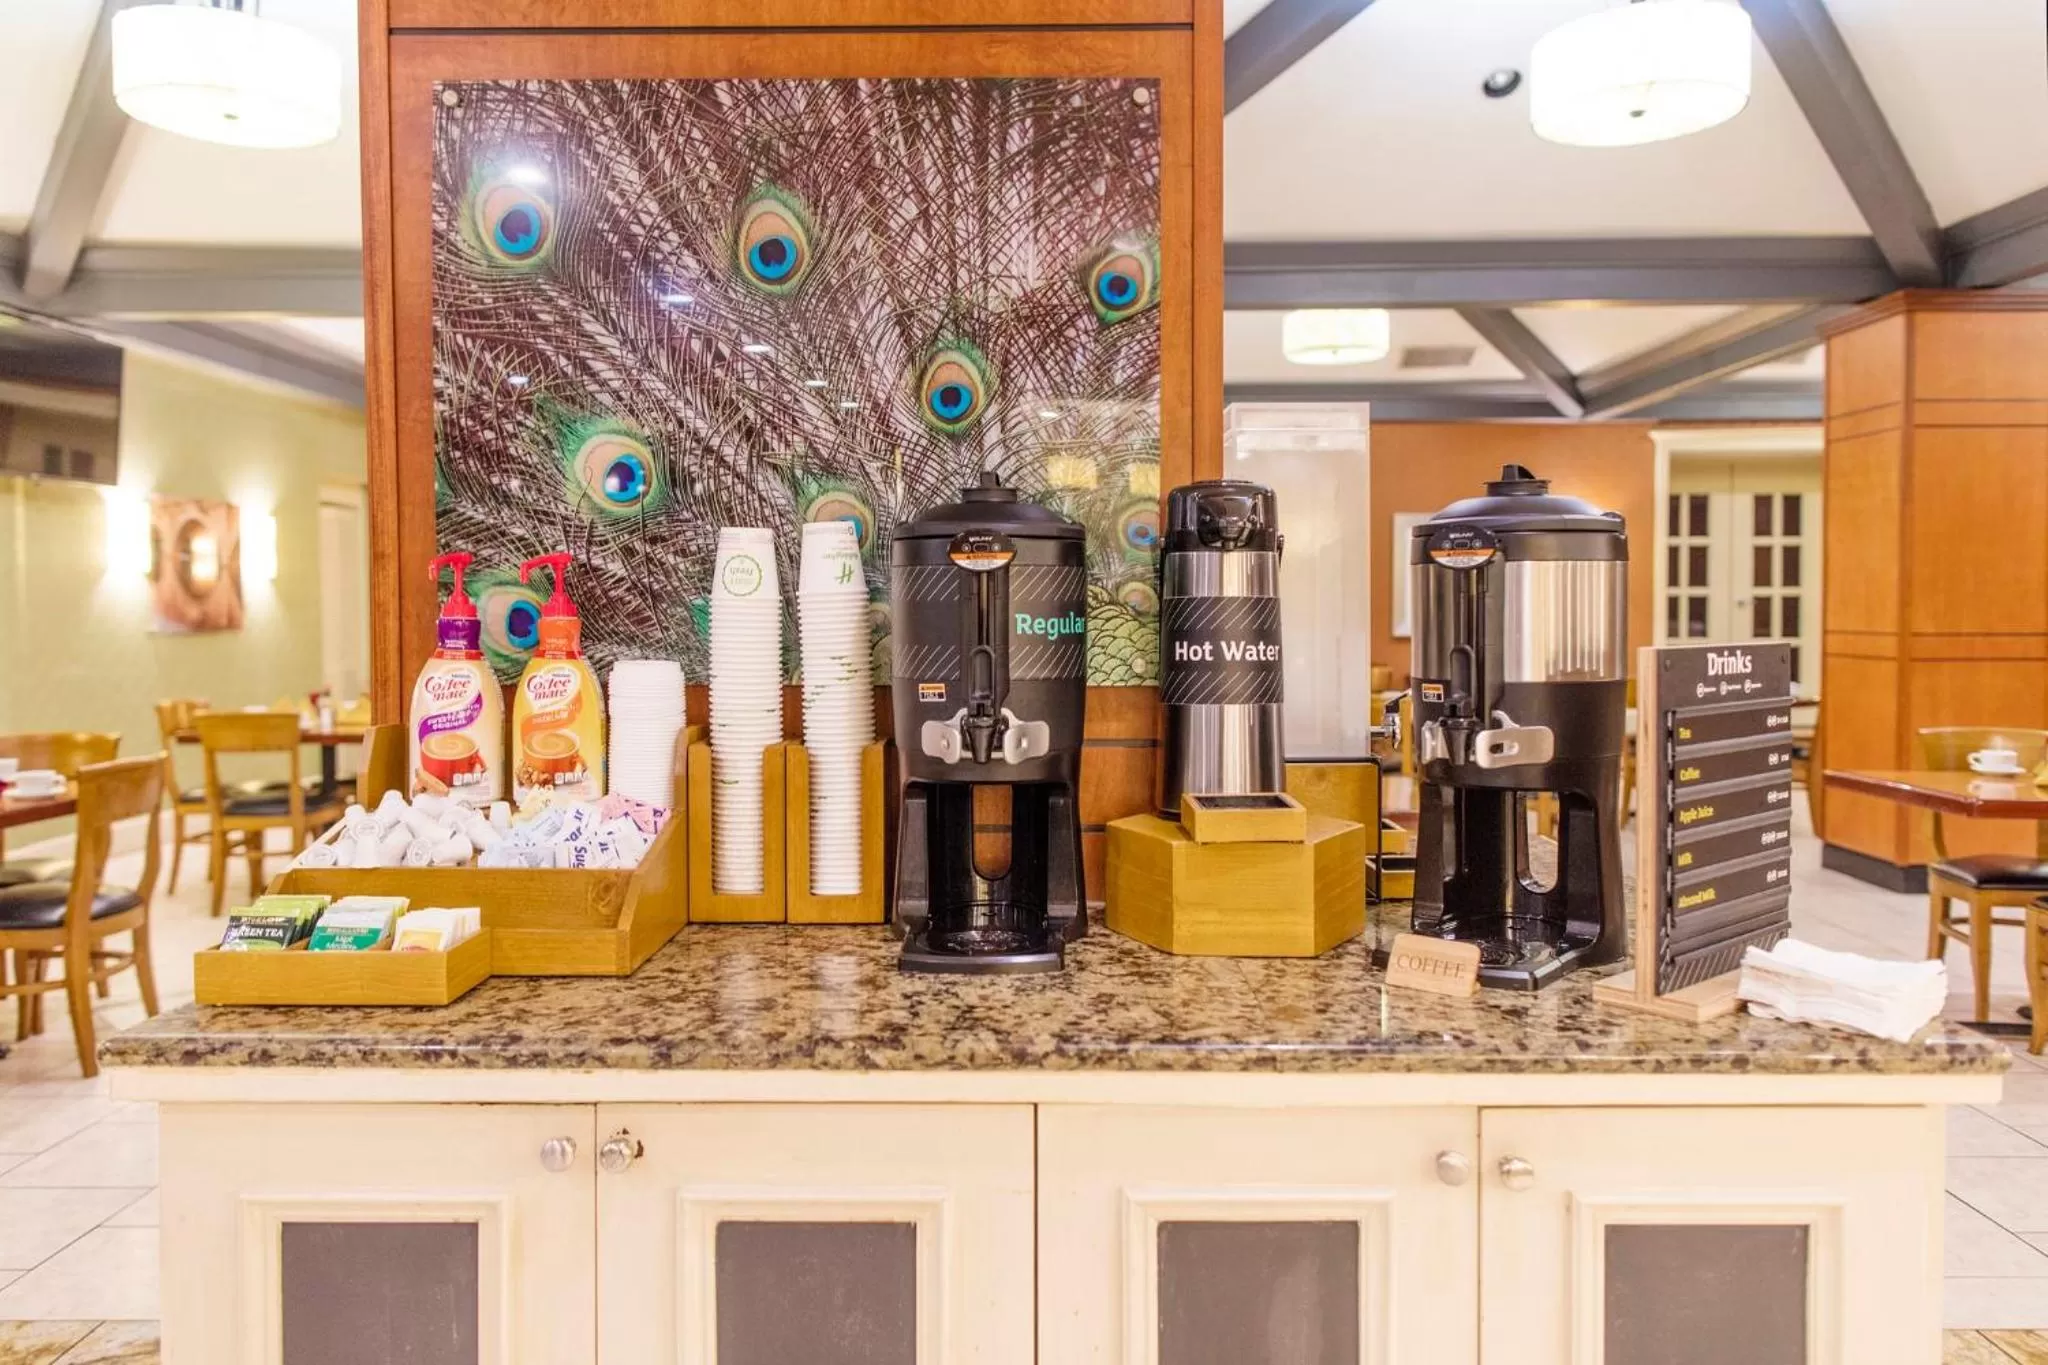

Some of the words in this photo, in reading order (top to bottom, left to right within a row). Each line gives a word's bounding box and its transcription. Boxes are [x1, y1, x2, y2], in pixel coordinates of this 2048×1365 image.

[1175, 641, 1214, 661] Hot
[1221, 641, 1280, 661] Water
[1707, 650, 1752, 676] Drinks
[1680, 767, 1700, 781] Coffee
[1680, 808, 1697, 824] Apple
[264, 927, 284, 937] TEA
[1396, 953, 1466, 979] COFFEE
